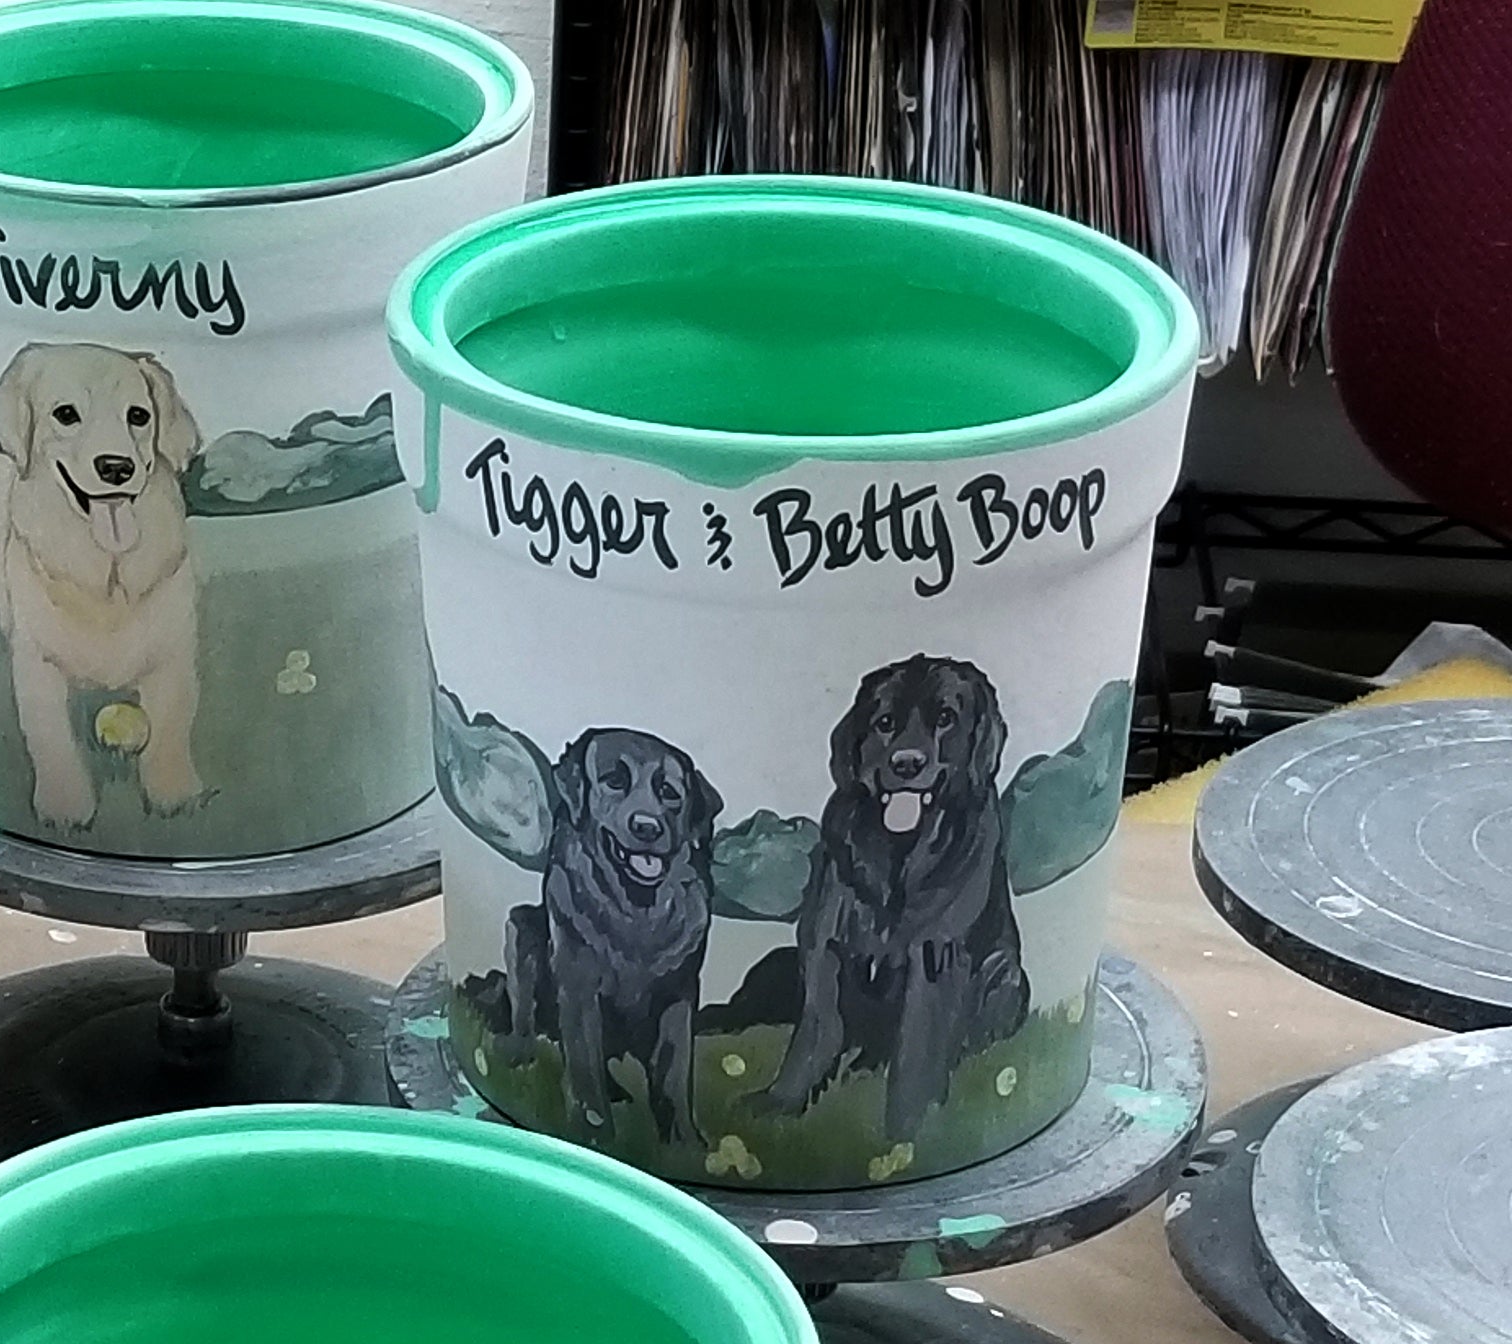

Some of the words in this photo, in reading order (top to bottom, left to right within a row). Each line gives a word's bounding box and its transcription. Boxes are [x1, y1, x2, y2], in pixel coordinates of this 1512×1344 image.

[466, 438, 679, 580] Tigger
[753, 482, 954, 598] Betty
[956, 468, 1105, 566] Boop
